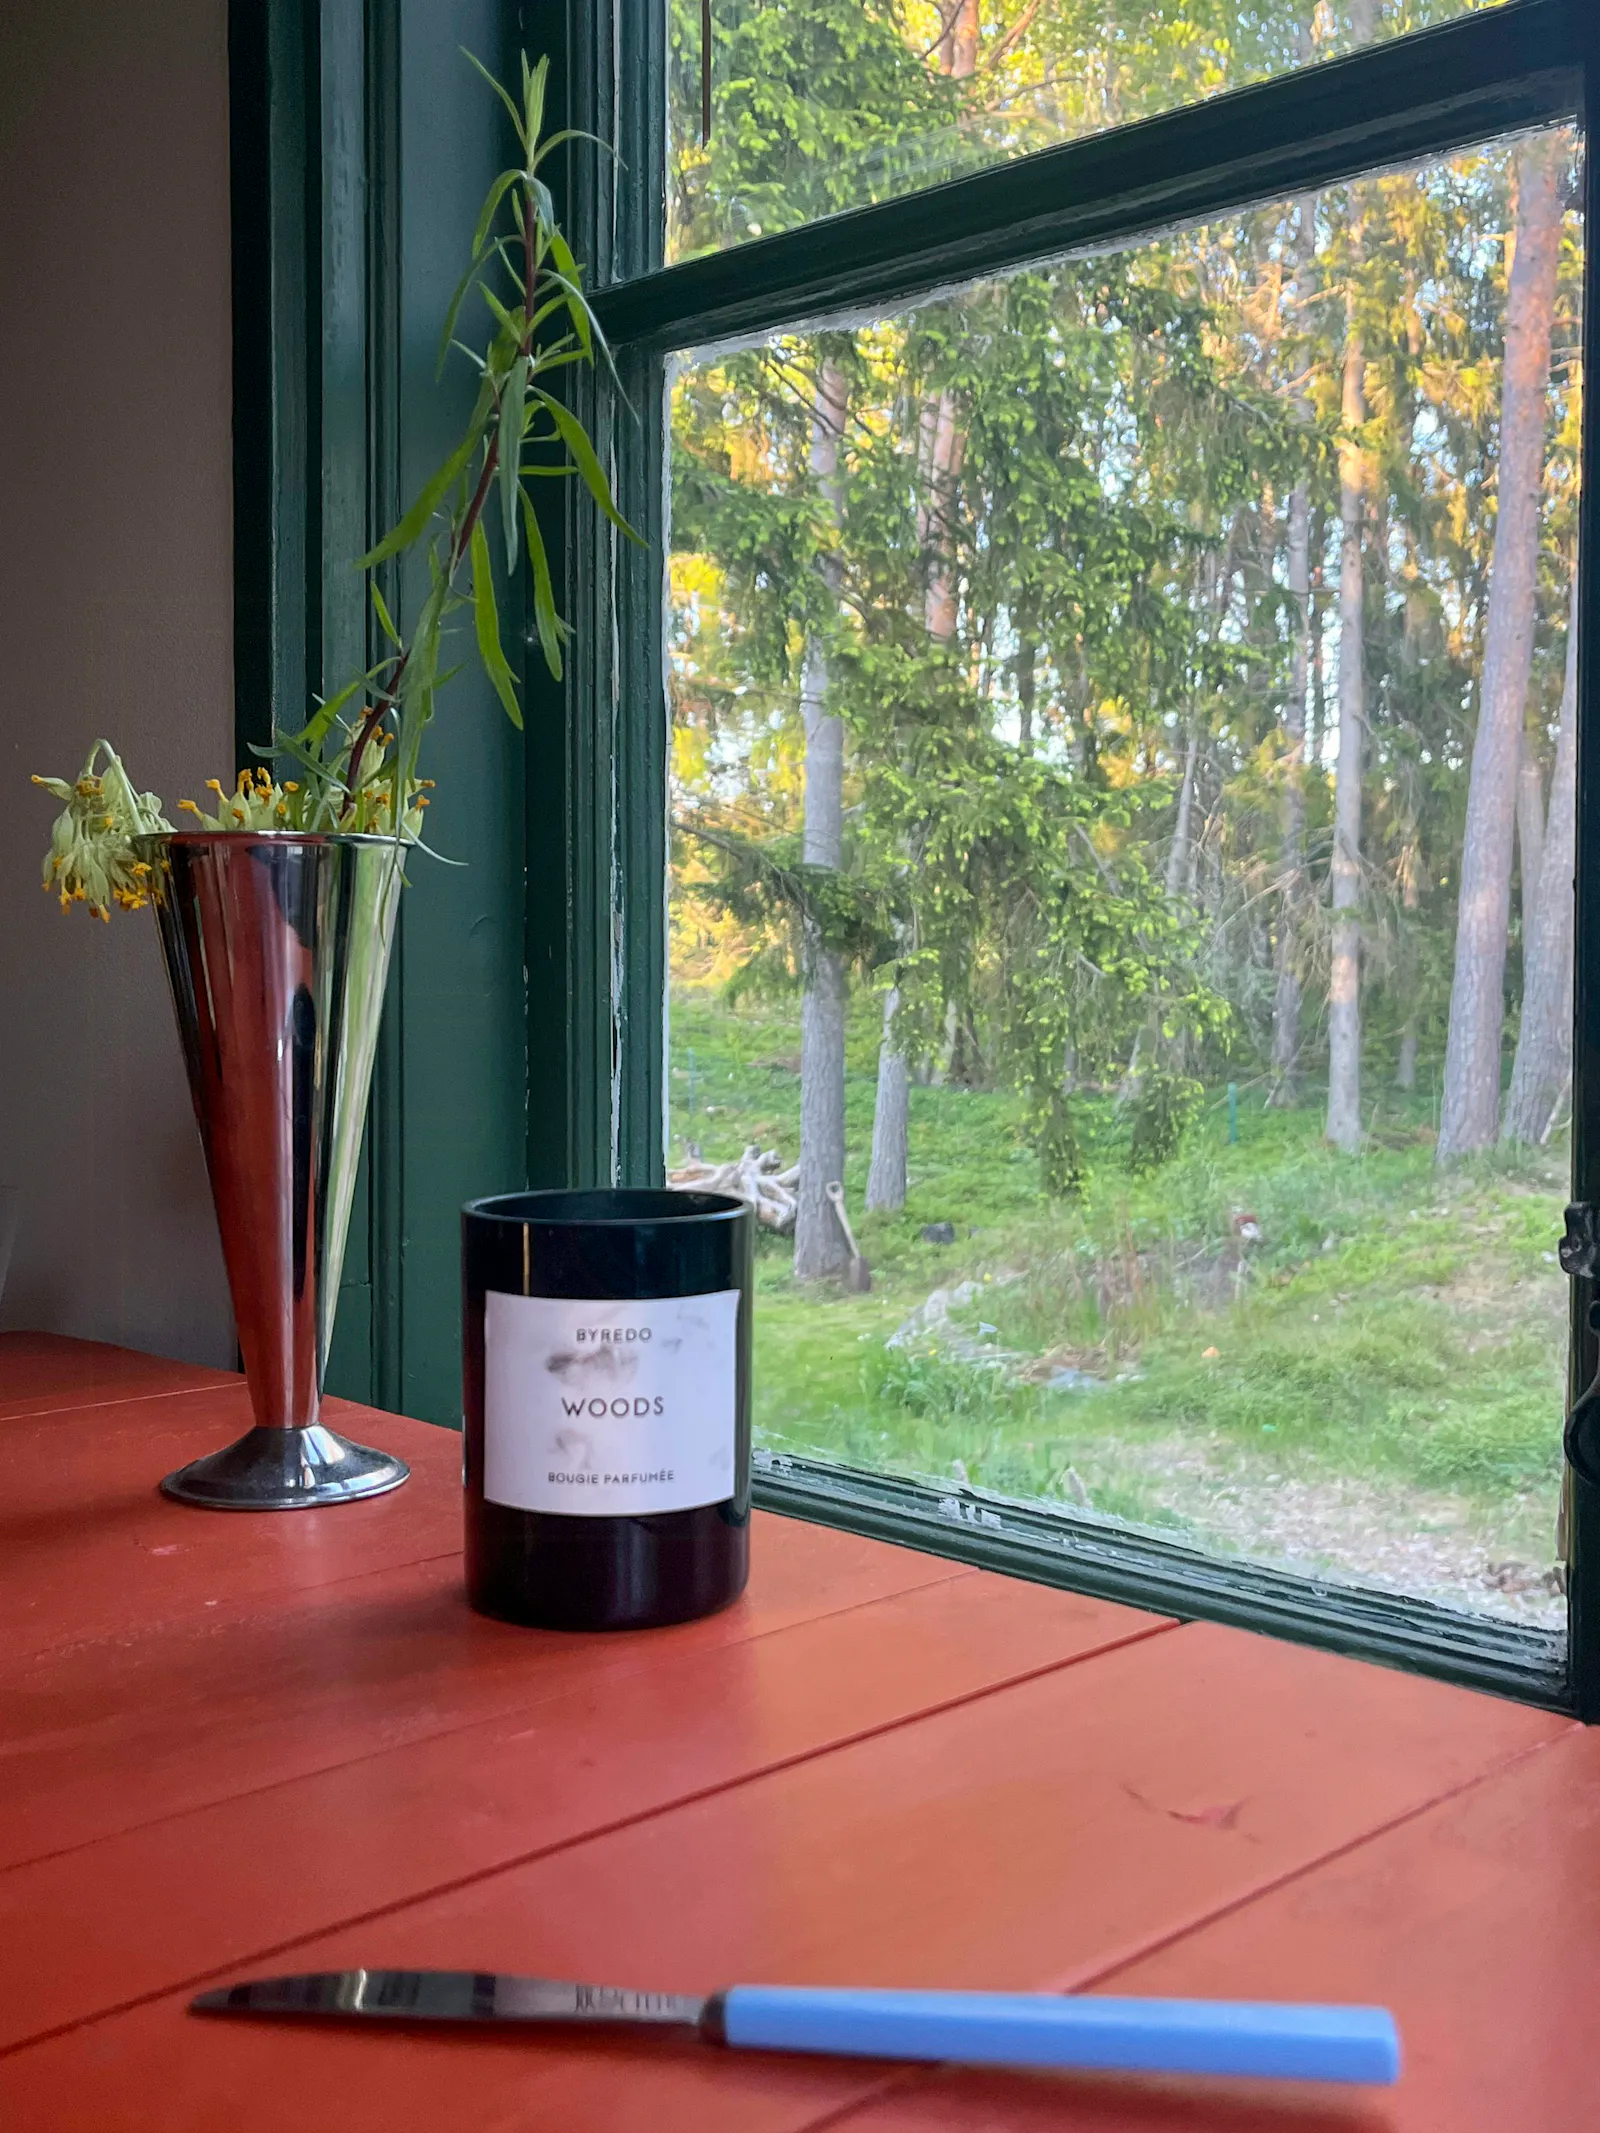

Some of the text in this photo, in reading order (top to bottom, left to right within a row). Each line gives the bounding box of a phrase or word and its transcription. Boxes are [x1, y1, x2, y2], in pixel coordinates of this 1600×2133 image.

[576, 1328, 653, 1342] BYREDO
[561, 1396, 665, 1418] WOODS
[547, 1469, 675, 1484] BOUGIE PARFUMÉE
